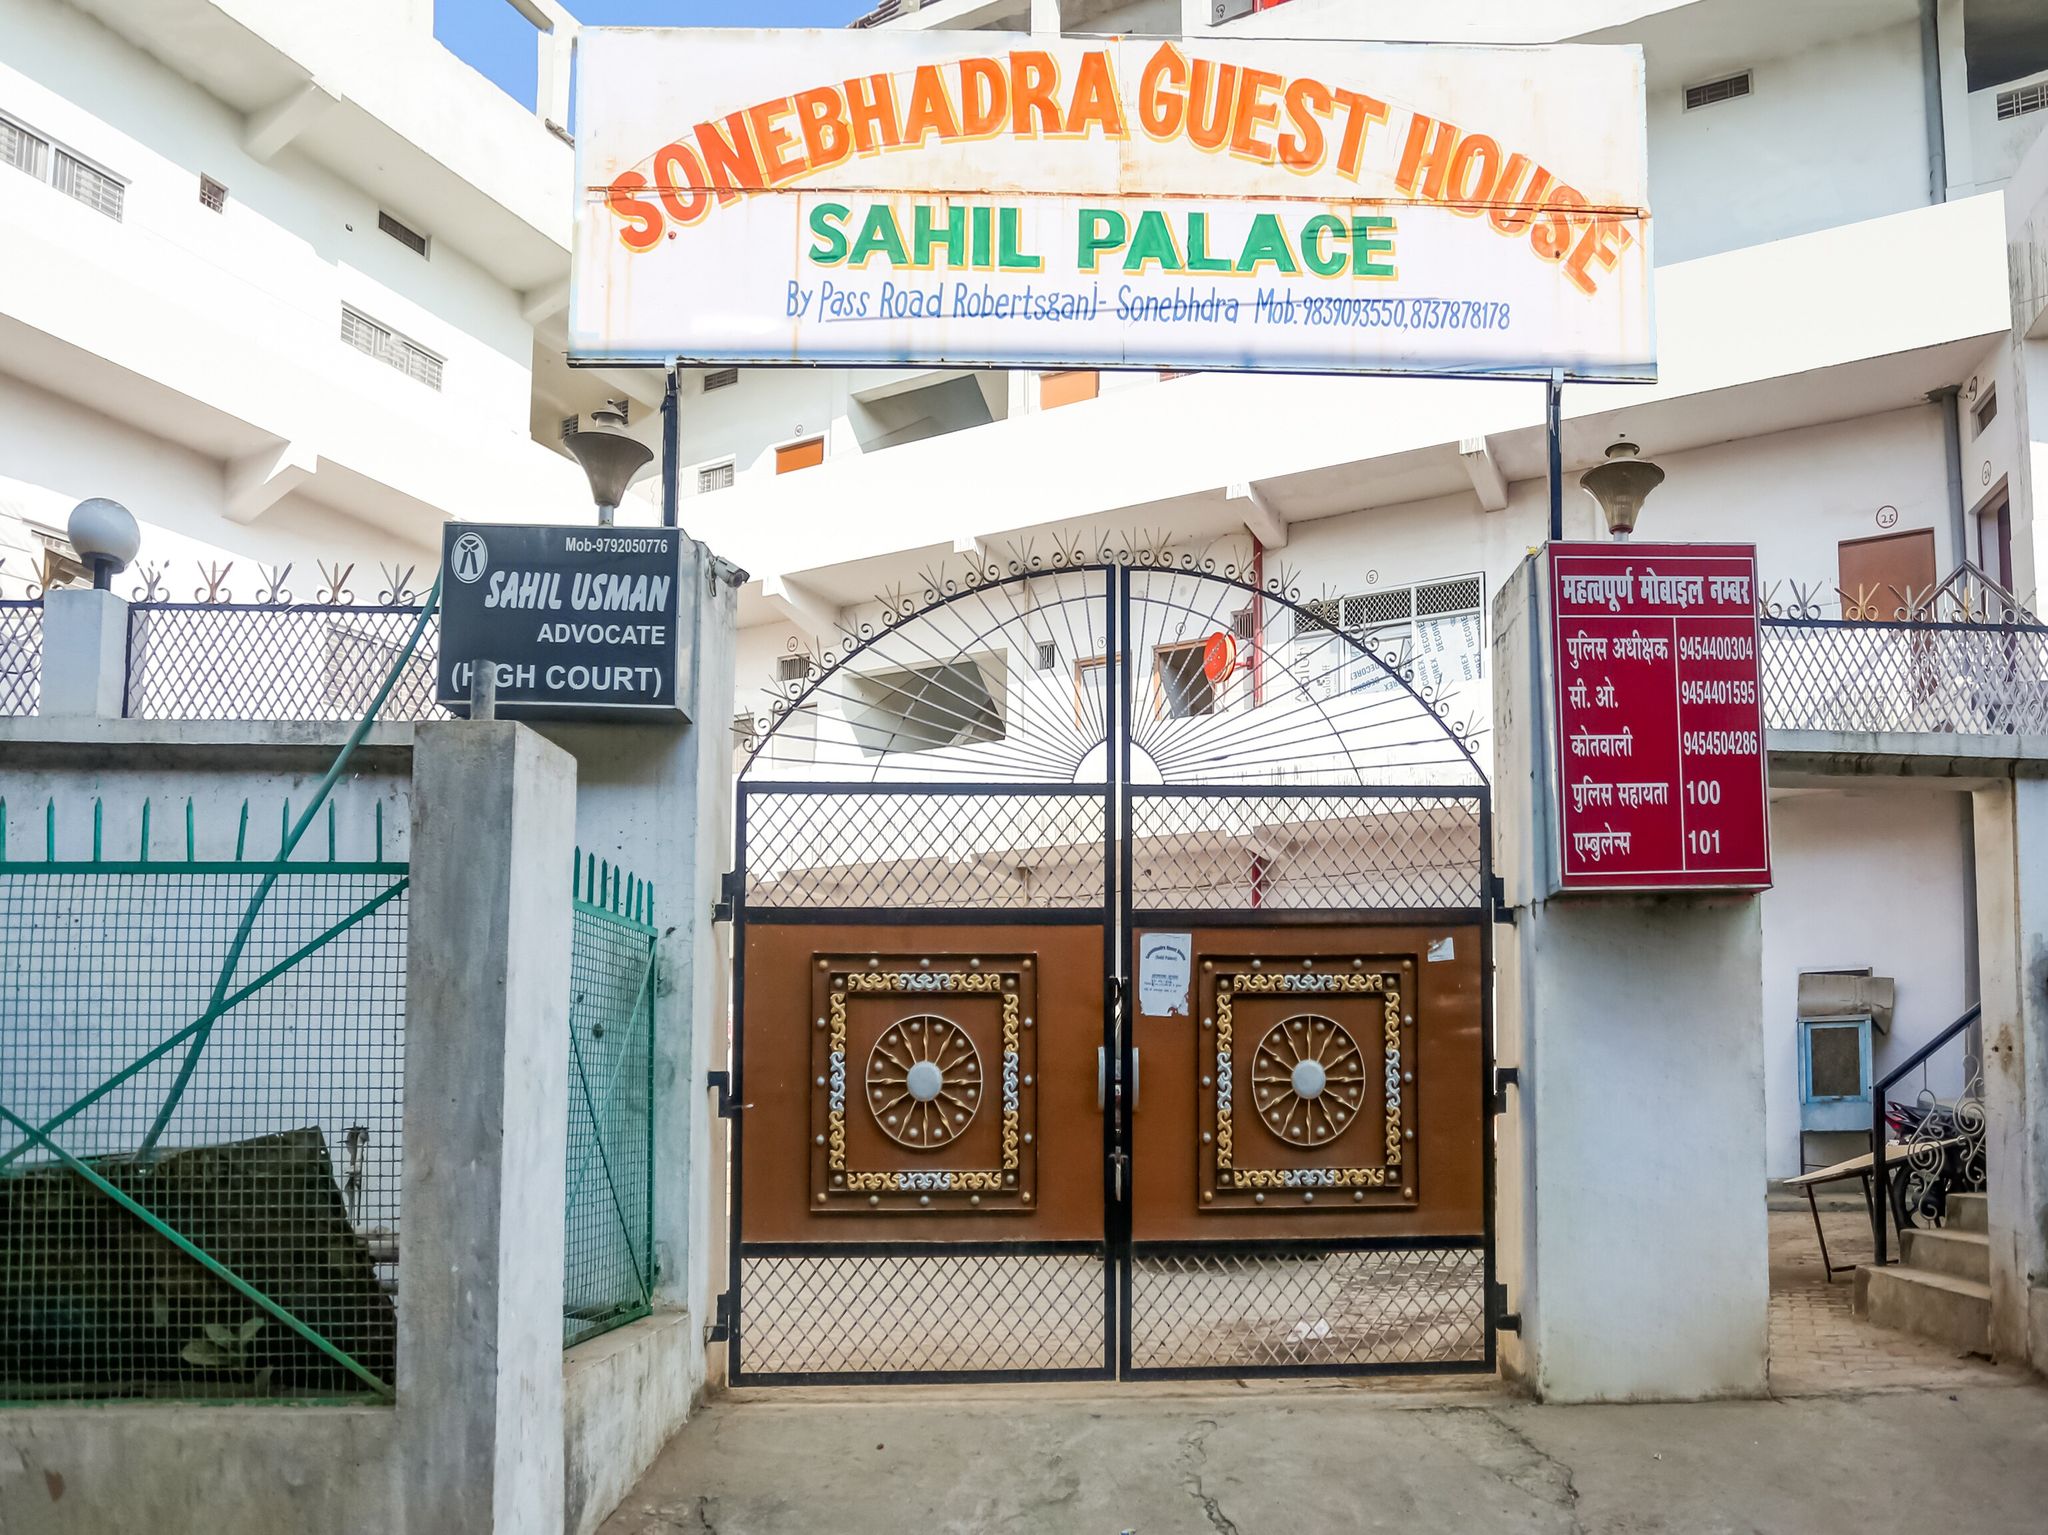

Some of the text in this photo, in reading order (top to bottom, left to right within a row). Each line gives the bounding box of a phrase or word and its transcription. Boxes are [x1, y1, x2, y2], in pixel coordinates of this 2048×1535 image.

[605, 41, 1632, 296] SONEBHADRA GUEST HOUSE
[808, 203, 1398, 281] SAHIL PALACE
[786, 280, 813, 318] By
[818, 280, 870, 323] Pass
[880, 282, 943, 318] Road
[1116, 285, 1239, 323] Sonebhdra
[565, 537, 668, 553] Mob-9792050776
[484, 570, 670, 612] SAHIL USMAN
[1638, 567, 1704, 608] मोबाइल
[1708, 576, 1750, 604] नम्बर
[537, 623, 665, 645] ADVOCATE
[1566, 629, 1669, 669] पुलिस अधीक्षक
[1680, 636, 1753, 660] 9454400304
[451, 662, 662, 698] (HGH COURT)
[1681, 681, 1755, 704] 9454401595
[1570, 725, 1633, 757] कोतवाली
[1683, 731, 1758, 755] 9454504286
[1571, 775, 1669, 813] पुलिस सहायता
[1686, 780, 1721, 804] 100
[1688, 830, 1721, 854] 101
